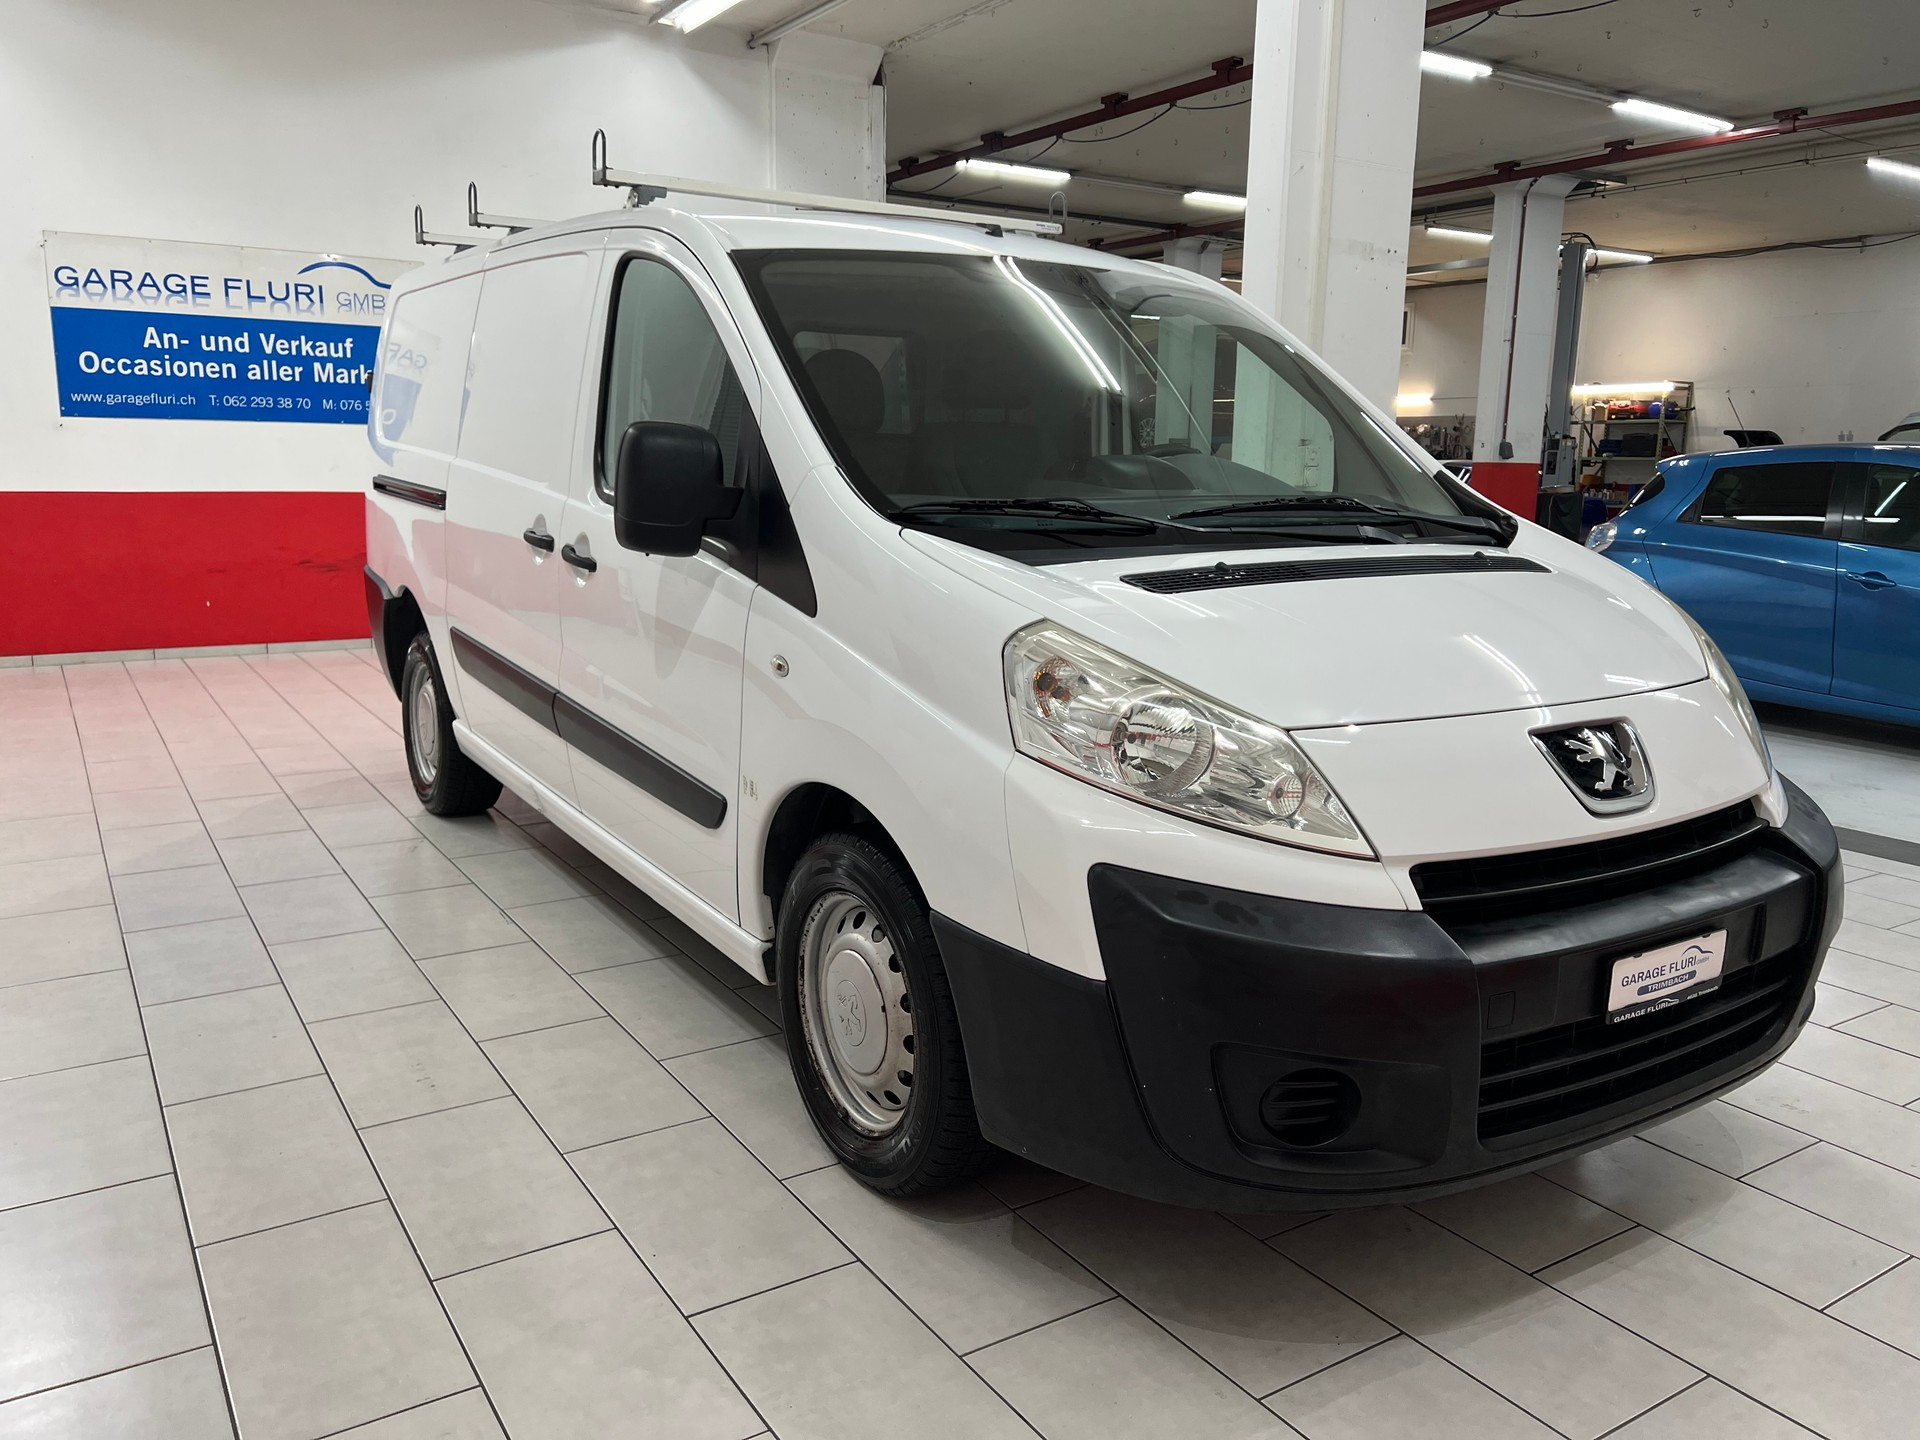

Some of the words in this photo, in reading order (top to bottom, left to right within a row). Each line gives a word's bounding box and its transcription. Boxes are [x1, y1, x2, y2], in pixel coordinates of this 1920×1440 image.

[54, 265, 211, 296] GARAGE
[223, 277, 323, 304] FLURI
[143, 326, 190, 349] An-
[200, 331, 250, 353] und
[259, 332, 353, 359] Verkauf
[78, 350, 237, 379] Occasionen
[247, 359, 303, 382] aller
[313, 361, 371, 385] Mark
[70, 392, 196, 406] www.garagefluri.ch
[208, 394, 220, 406] T:
[222, 395, 248, 407] 062
[250, 396, 274, 408] 293
[276, 397, 293, 409] 38
[296, 398, 312, 410] 70
[322, 399, 337, 410] M:
[339, 399, 363, 411] 076
[1621, 964, 1667, 987] GARAGE
[1668, 955, 1697, 974] FLURI
[1647, 974, 1689, 992] TRIMBACH
[1613, 1008, 1646, 1023] GARAGE
[1646, 1001, 1669, 1014] FLURI
